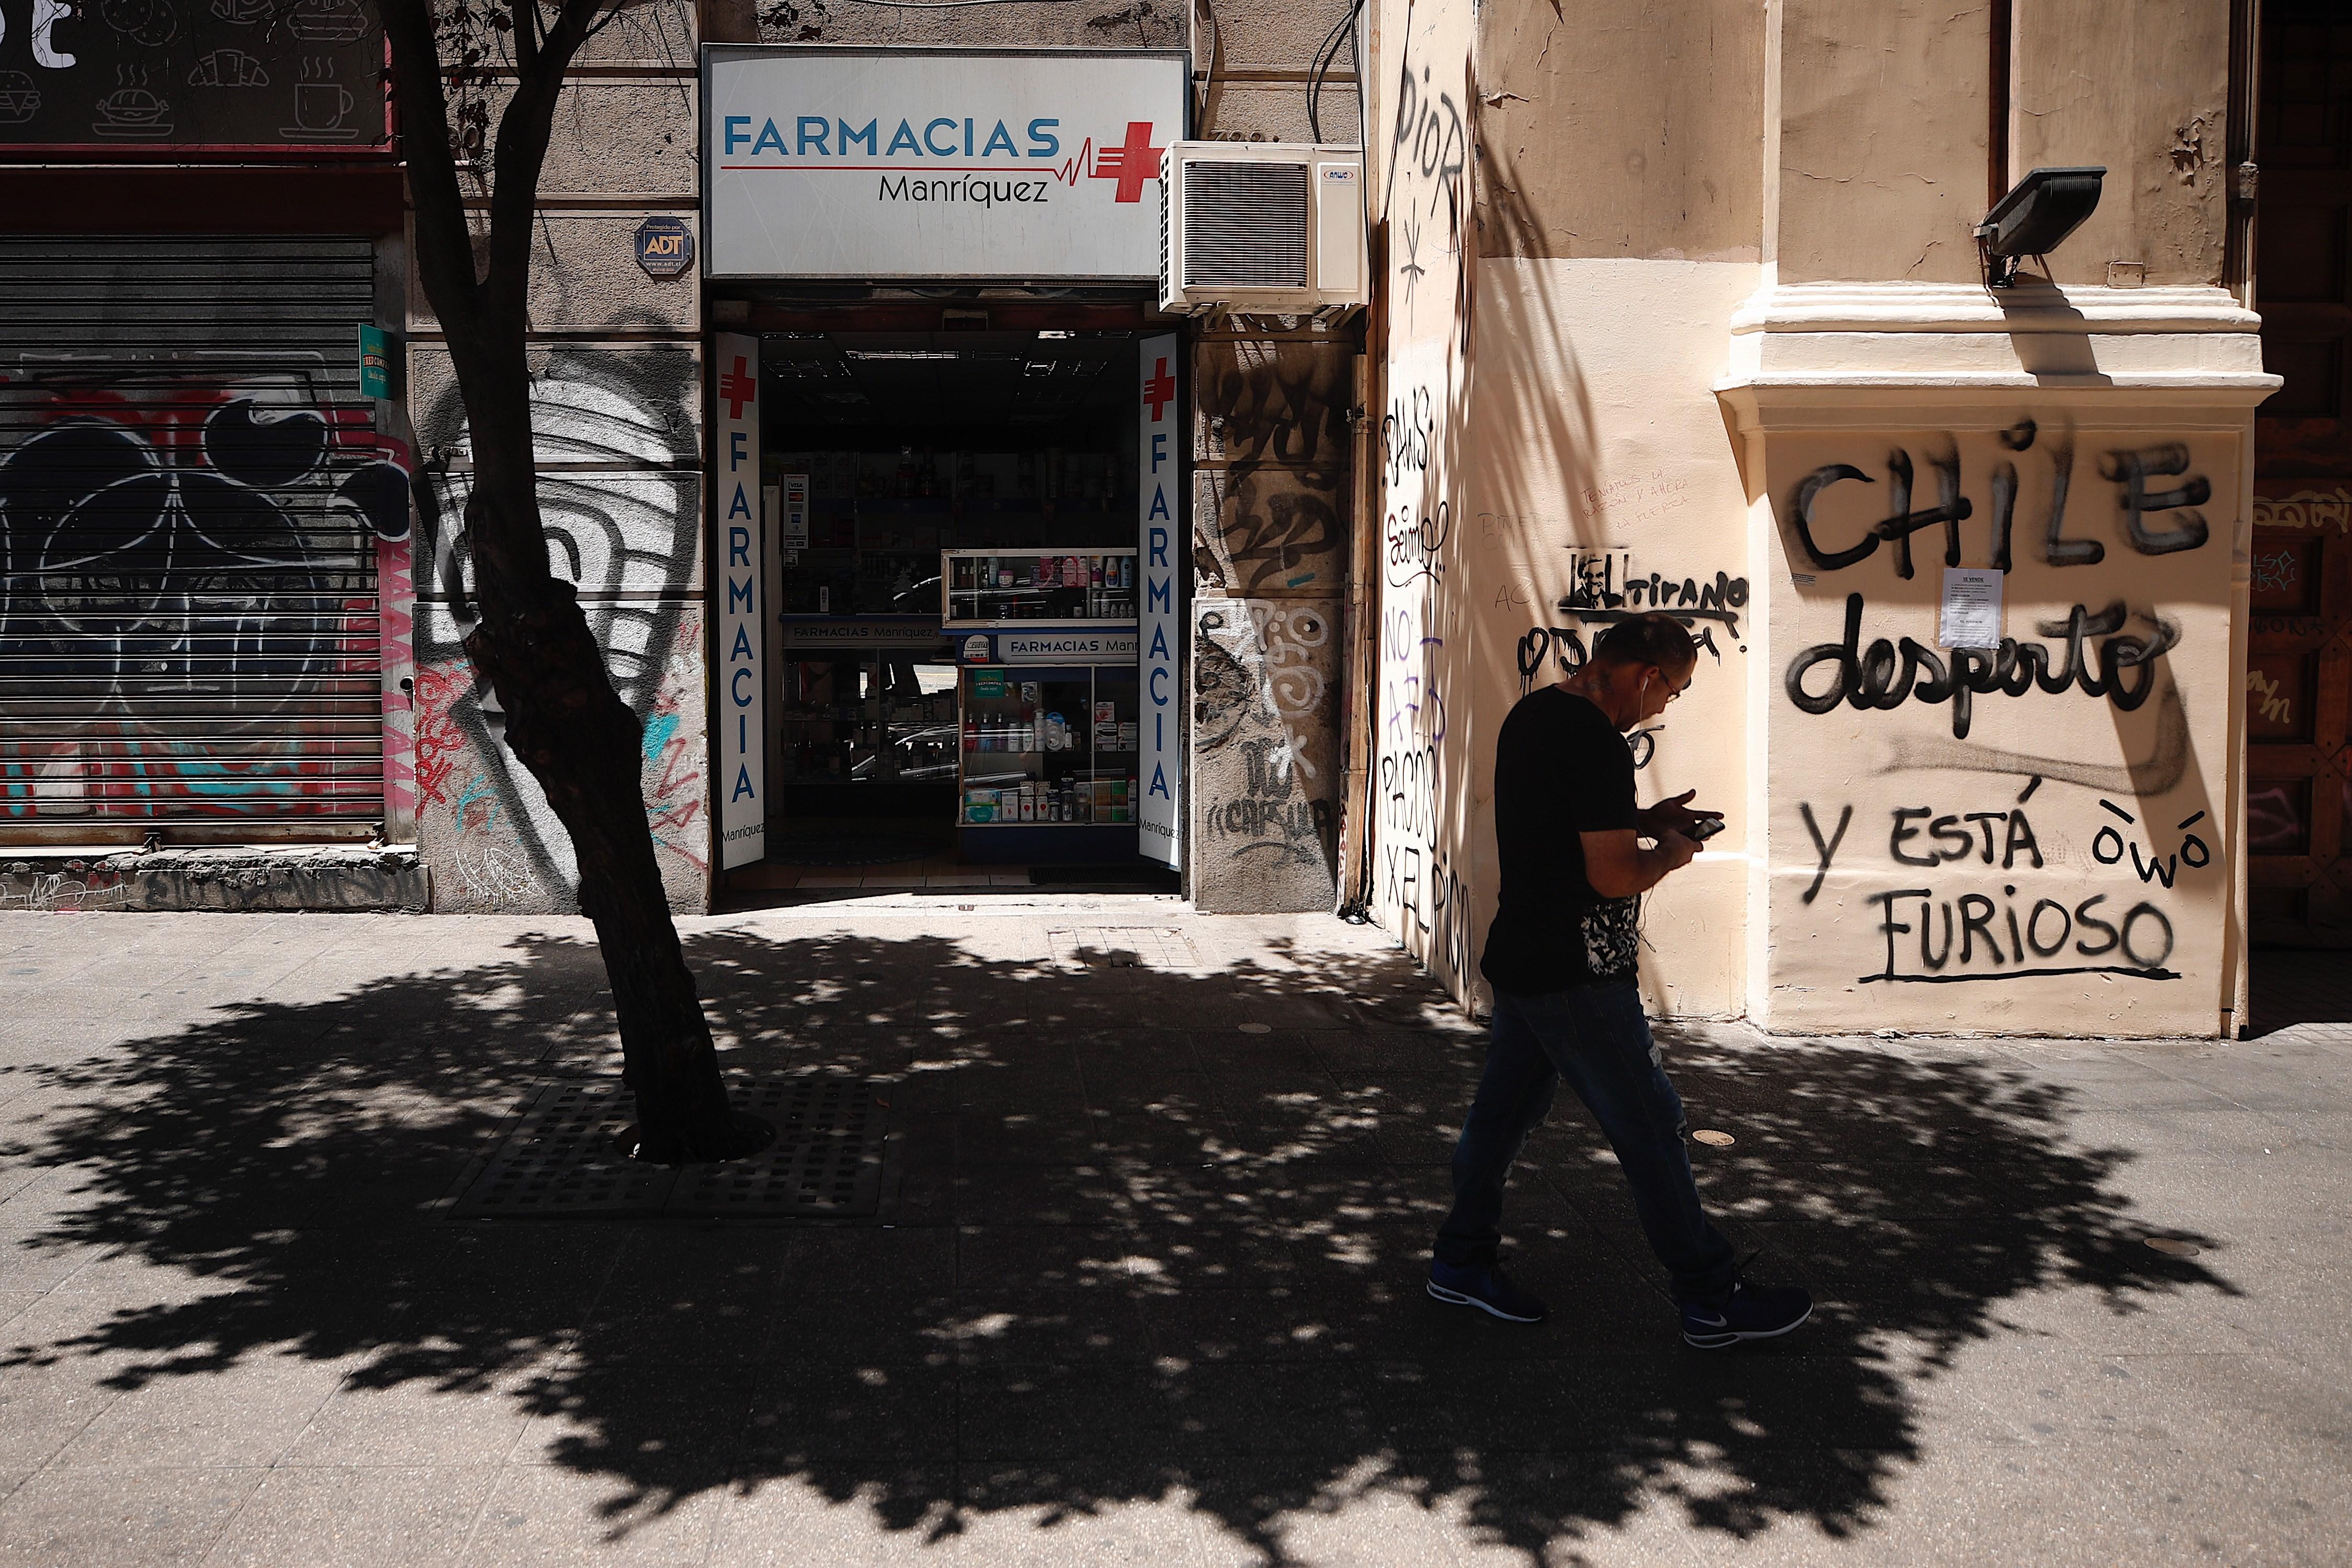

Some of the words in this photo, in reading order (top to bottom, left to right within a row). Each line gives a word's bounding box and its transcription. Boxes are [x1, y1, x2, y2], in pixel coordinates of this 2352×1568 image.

[724, 116, 1060, 157] FARMACIAS
[878, 173, 1049, 209] Manríquez
[644, 235, 683, 255] ADT
[728, 431, 755, 803] FARMACIA
[1148, 434, 1170, 800] FARMACIA
[794, 628, 868, 637] FARMACIAS
[874, 627, 933, 639] Manríquez
[1011, 640, 1099, 652] FARMACIAS
[722, 822, 765, 842] Manríquez
[1139, 818, 1179, 839] Manríquez
[1890, 776, 2044, 869] ESTÁ
